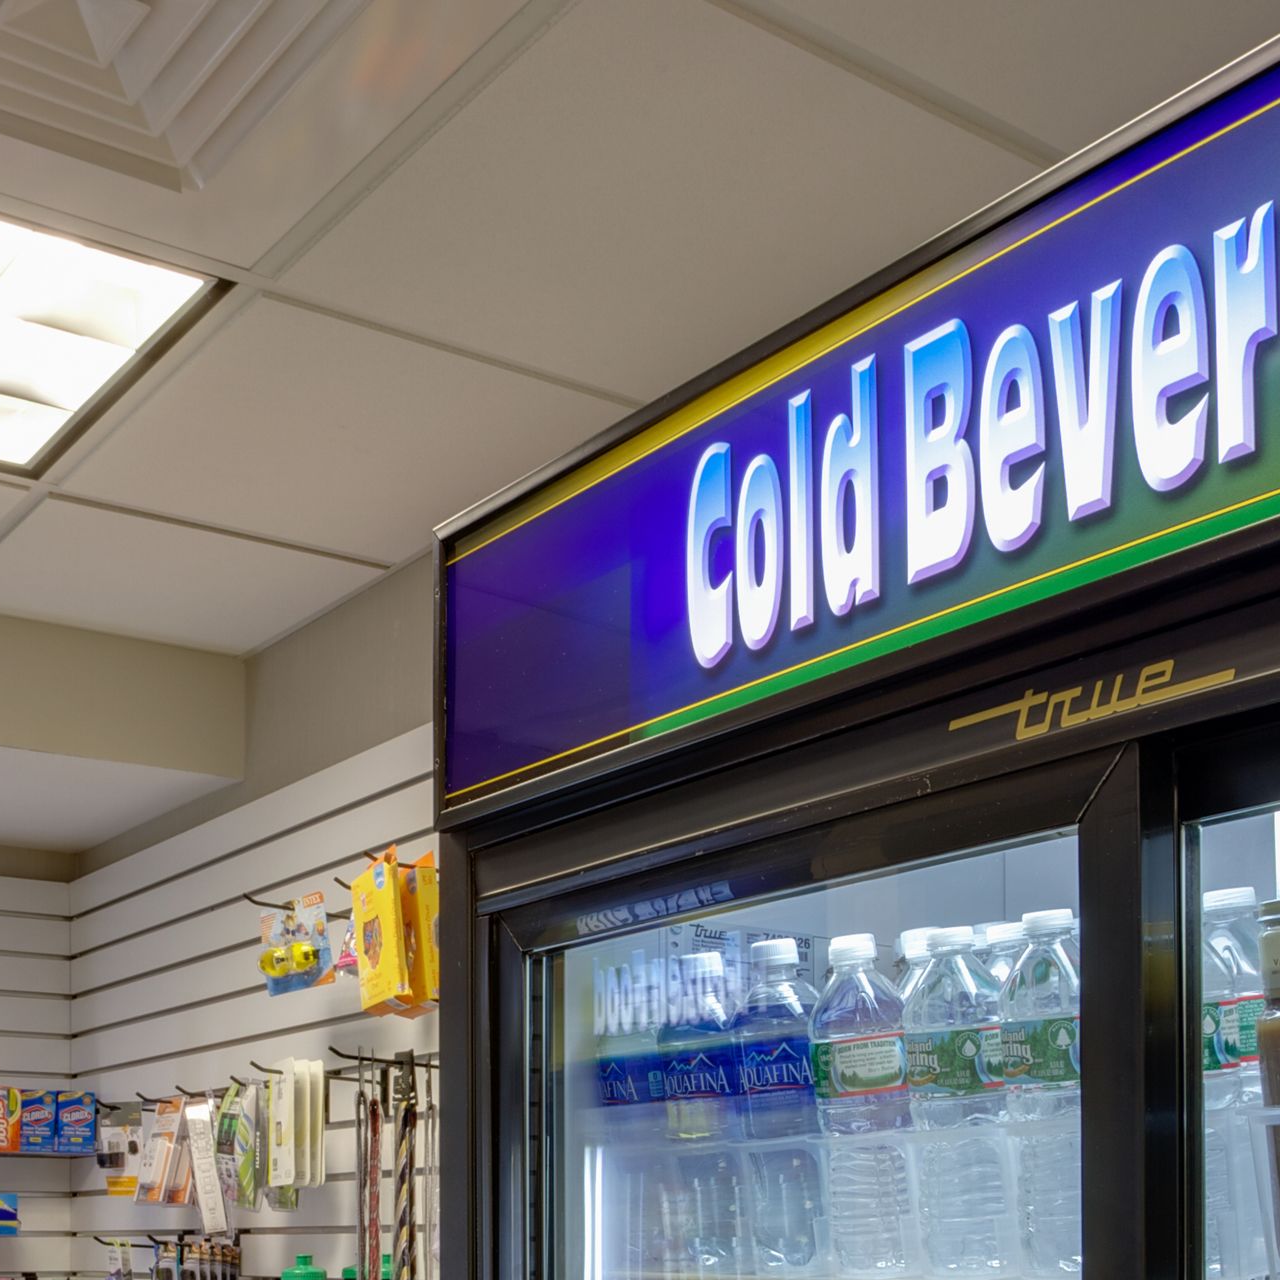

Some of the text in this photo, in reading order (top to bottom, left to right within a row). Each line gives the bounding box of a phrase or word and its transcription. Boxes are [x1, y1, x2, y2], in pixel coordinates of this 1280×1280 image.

[686, 351, 881, 669] Cold
[949, 658, 1236, 741] true
[689, 924, 728, 941] true
[739, 1055, 816, 1091] AQUAFINA
[22, 1110, 52, 1123] CLOROX
[62, 1110, 91, 1123] CLOROX
